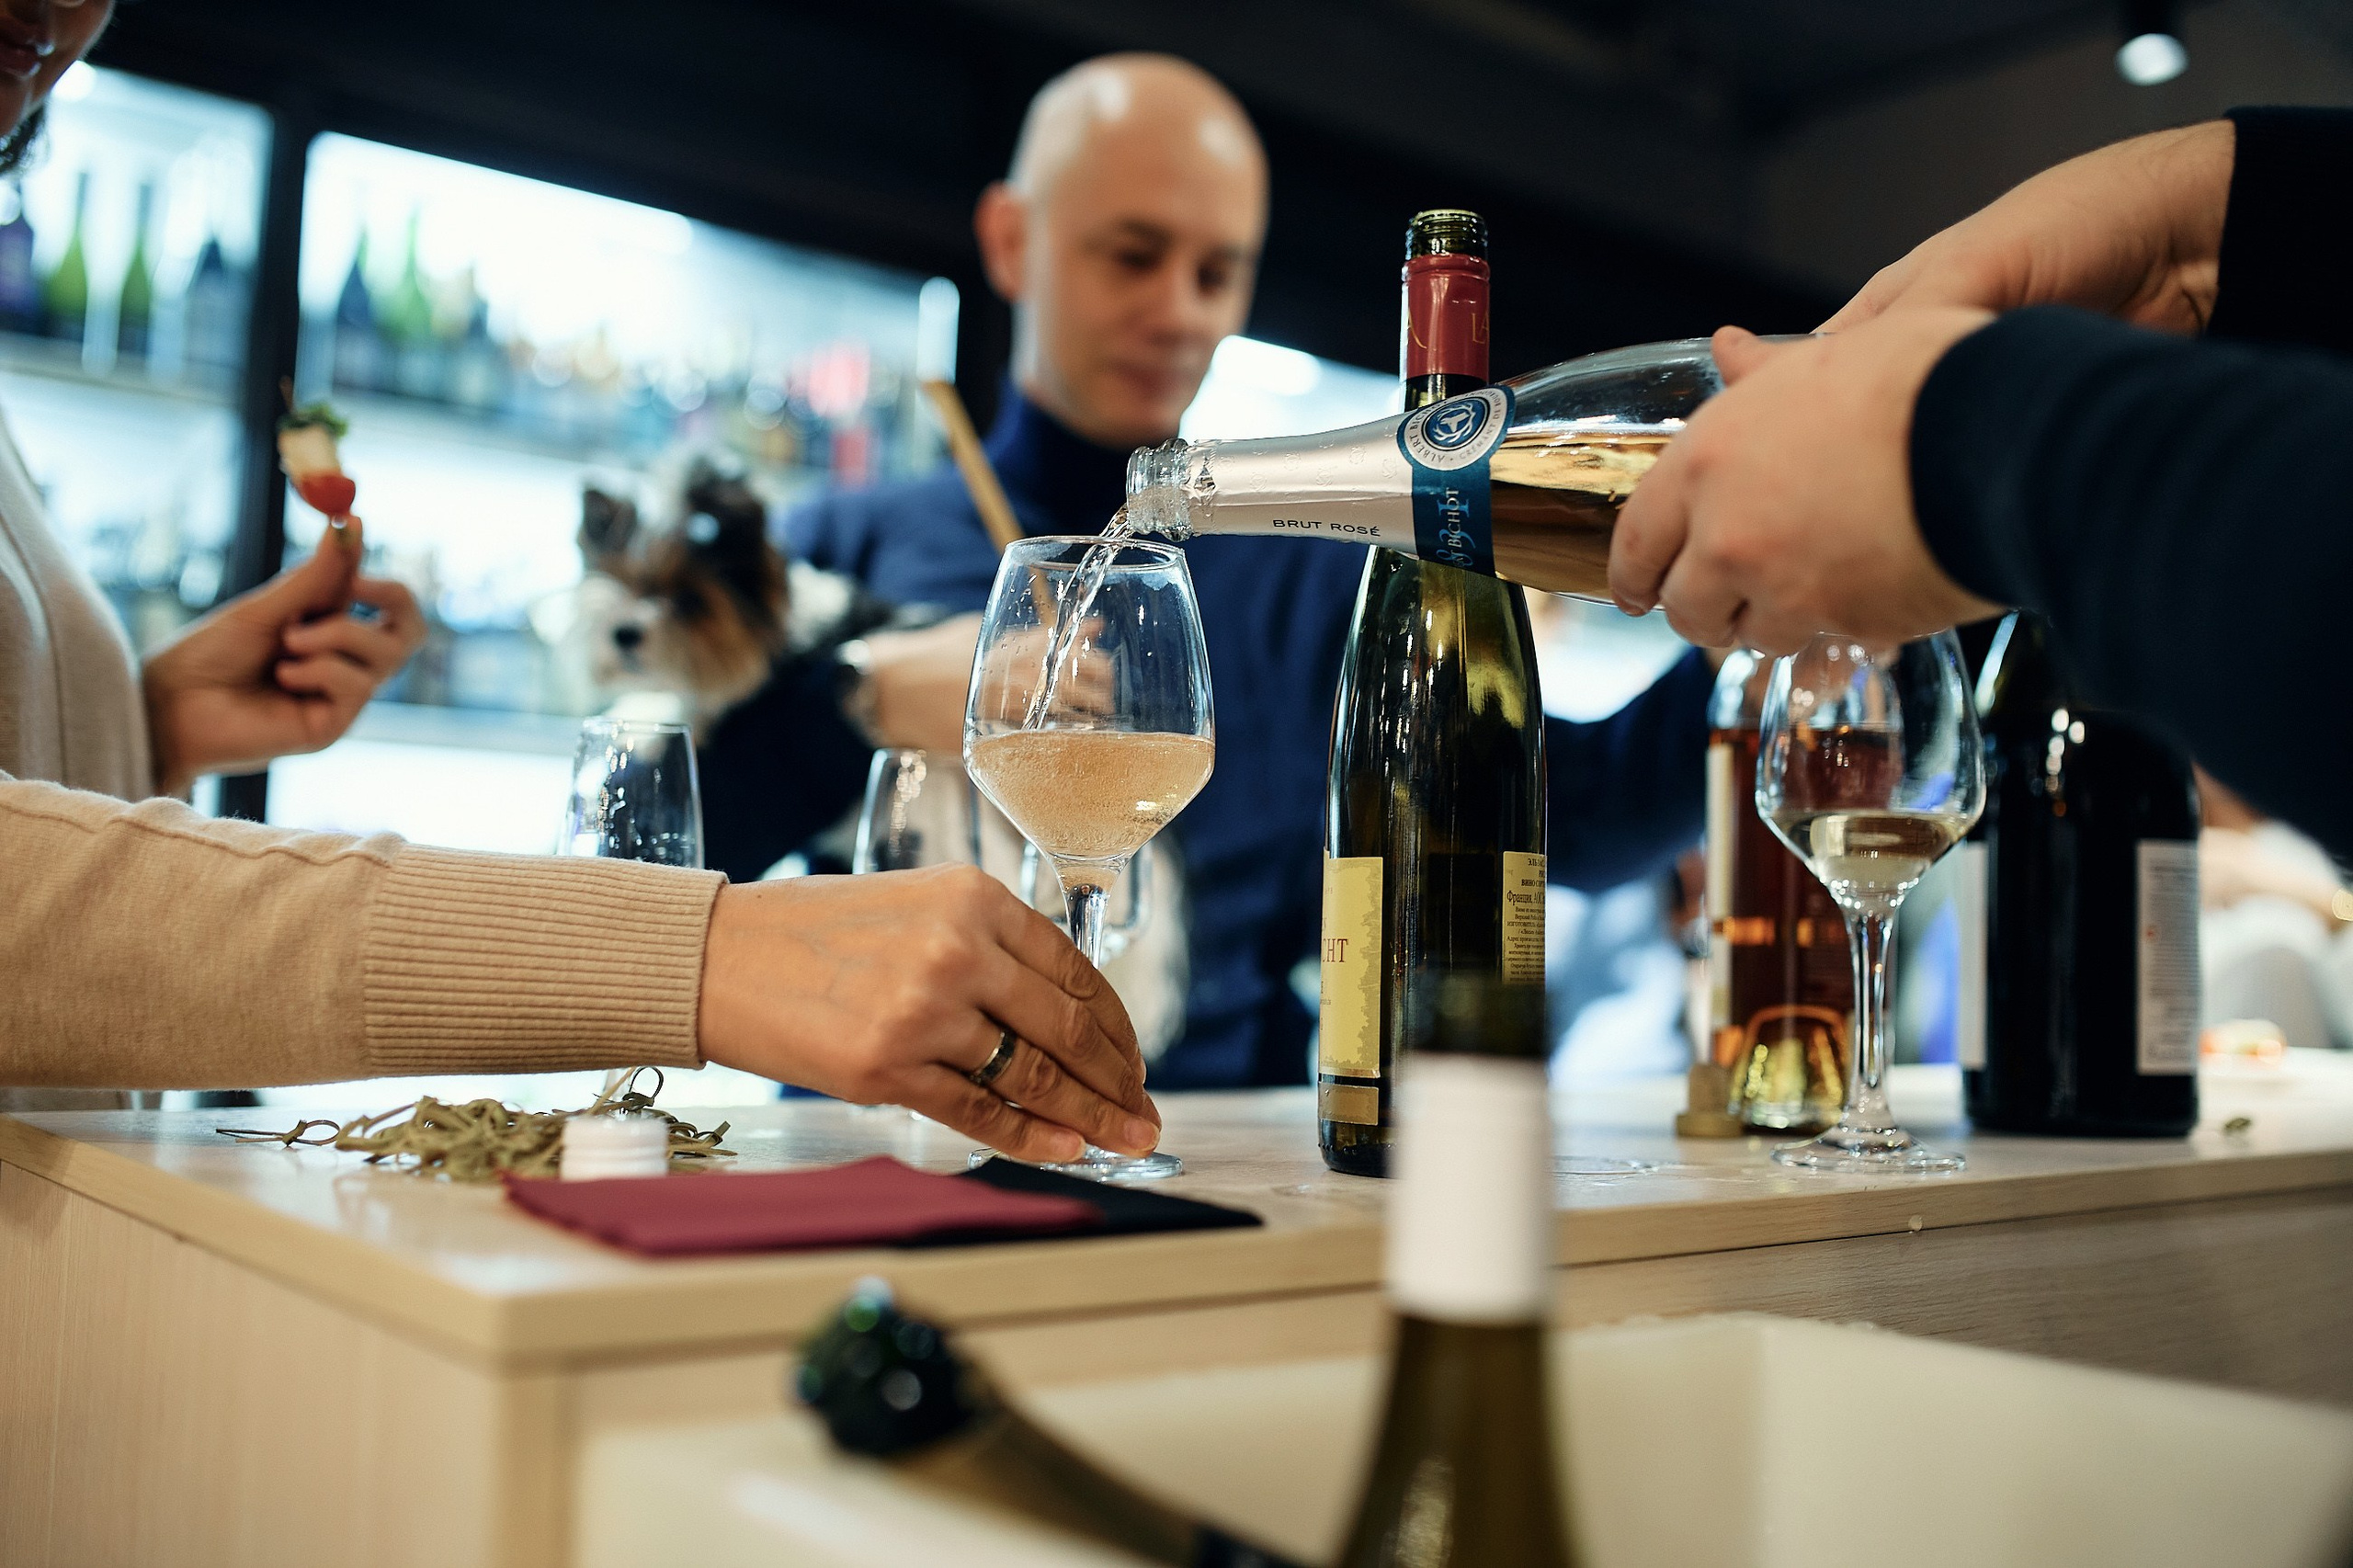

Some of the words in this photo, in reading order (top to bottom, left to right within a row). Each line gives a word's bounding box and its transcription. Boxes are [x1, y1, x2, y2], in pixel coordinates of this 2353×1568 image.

[1409, 435, 1446, 463] ALBERT
[1272, 519, 1323, 529] BRUT
[1330, 523, 1381, 537] ROSÉ
[1446, 487, 1462, 548] BICHOT
